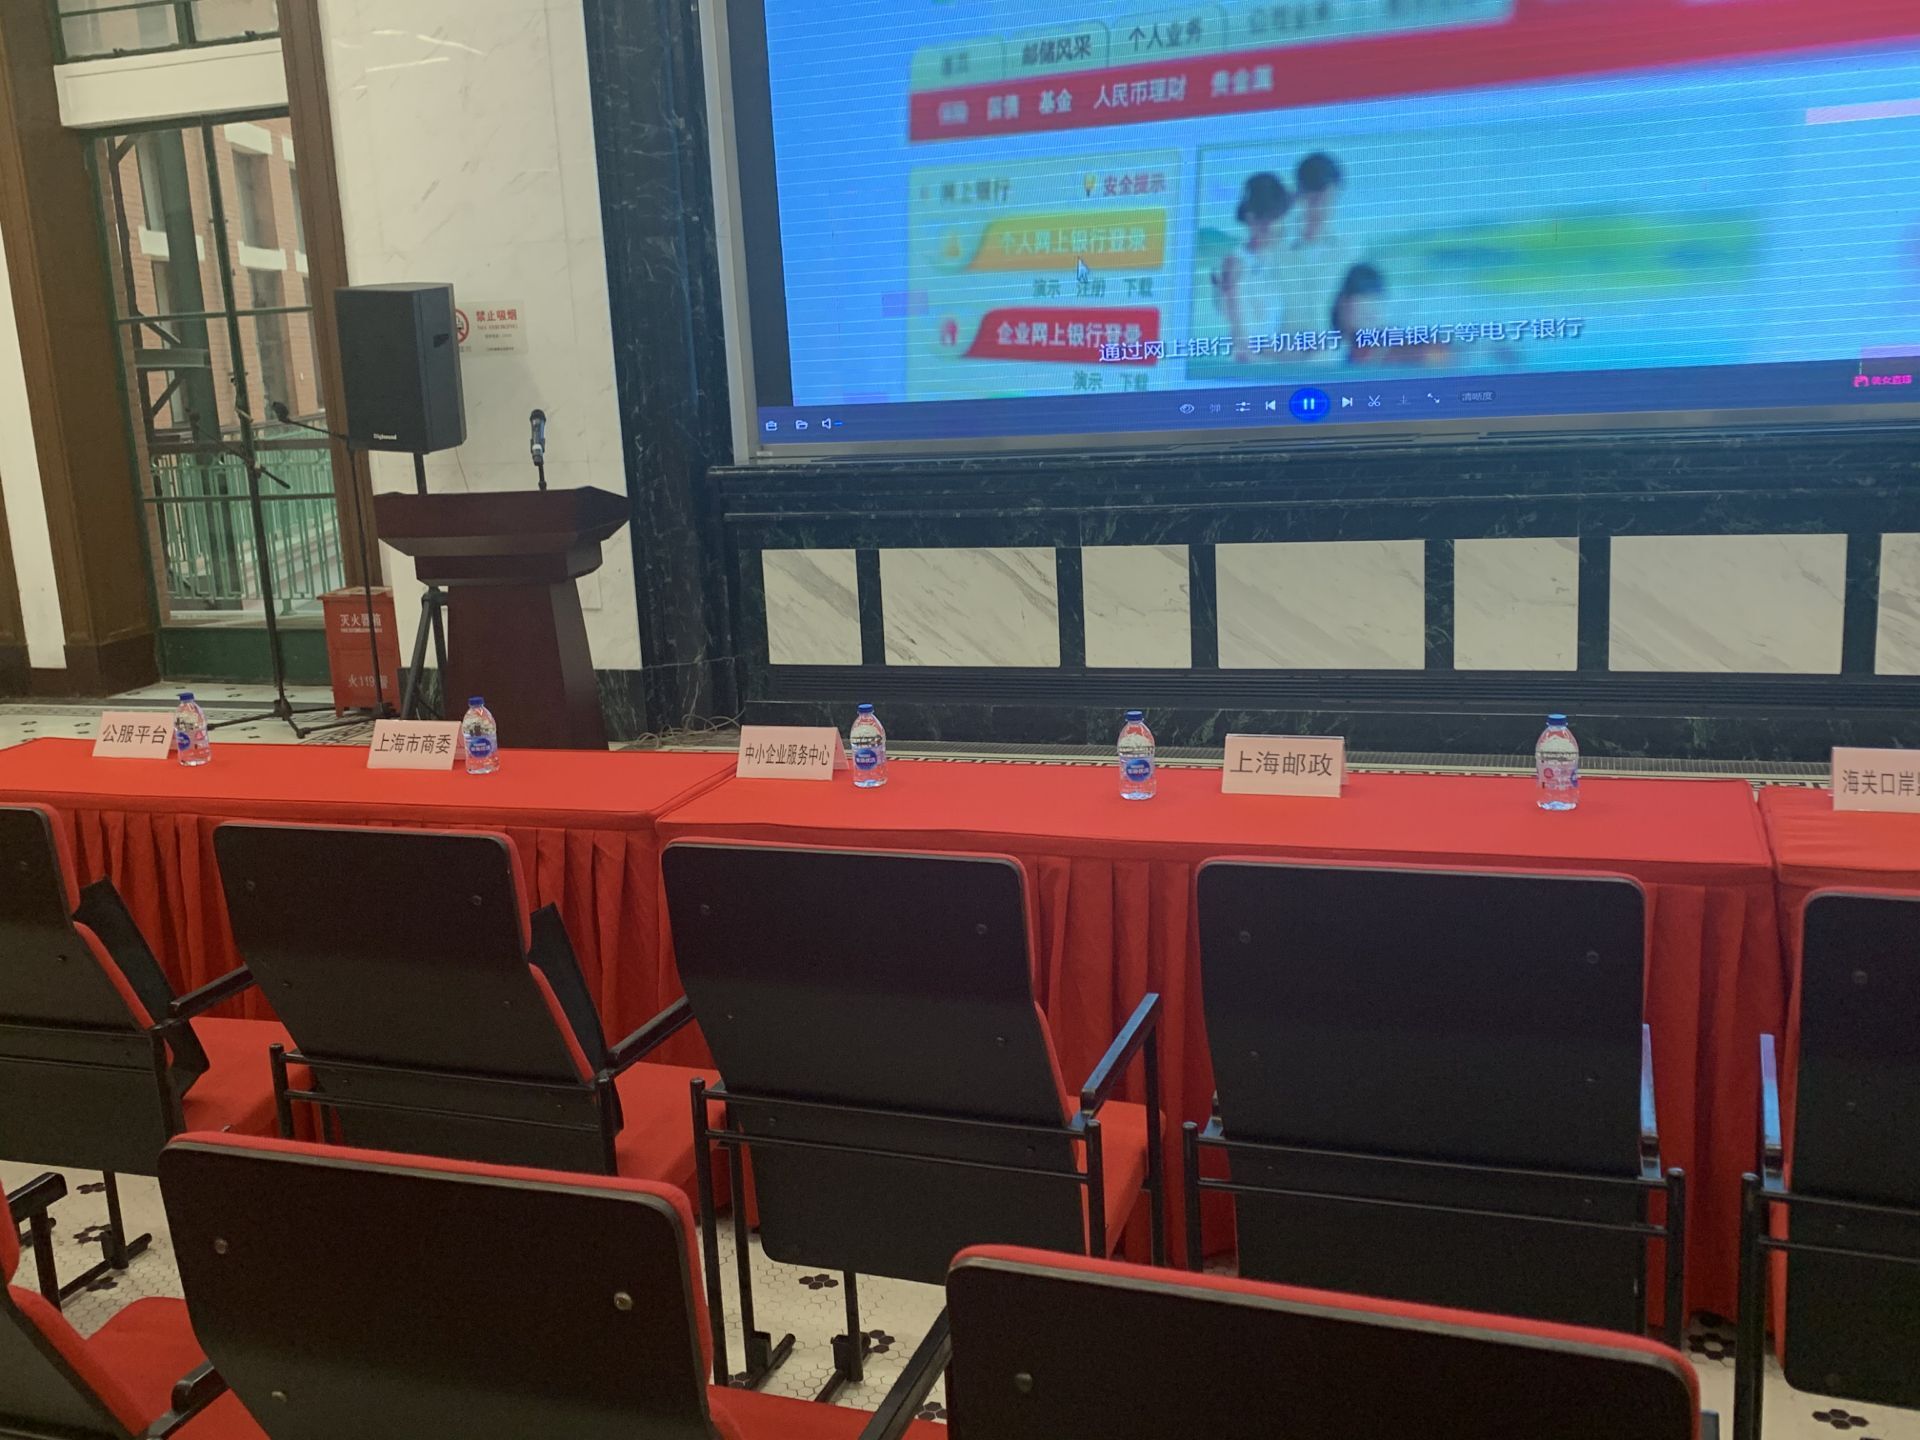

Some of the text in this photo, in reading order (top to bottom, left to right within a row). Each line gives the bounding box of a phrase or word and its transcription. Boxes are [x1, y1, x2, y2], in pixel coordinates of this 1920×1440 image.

[1128, 18, 1203, 53] 个人业务
[1039, 88, 1072, 114] 基金
[1093, 75, 1186, 109] 人民币理财
[1103, 172, 1166, 196] 安全提示
[476, 309, 517, 322] 禁止吸烟
[997, 322, 1142, 348] 企业网上银行登录
[1098, 316, 1584, 363] 通过网上银行 手机银行 微信银行等电子银行
[102, 724, 167, 744] 公服平台
[374, 732, 451, 754] 上海市商委
[745, 743, 830, 766] 中小企业服务中心
[1229, 750, 1333, 776] 上海邮政
